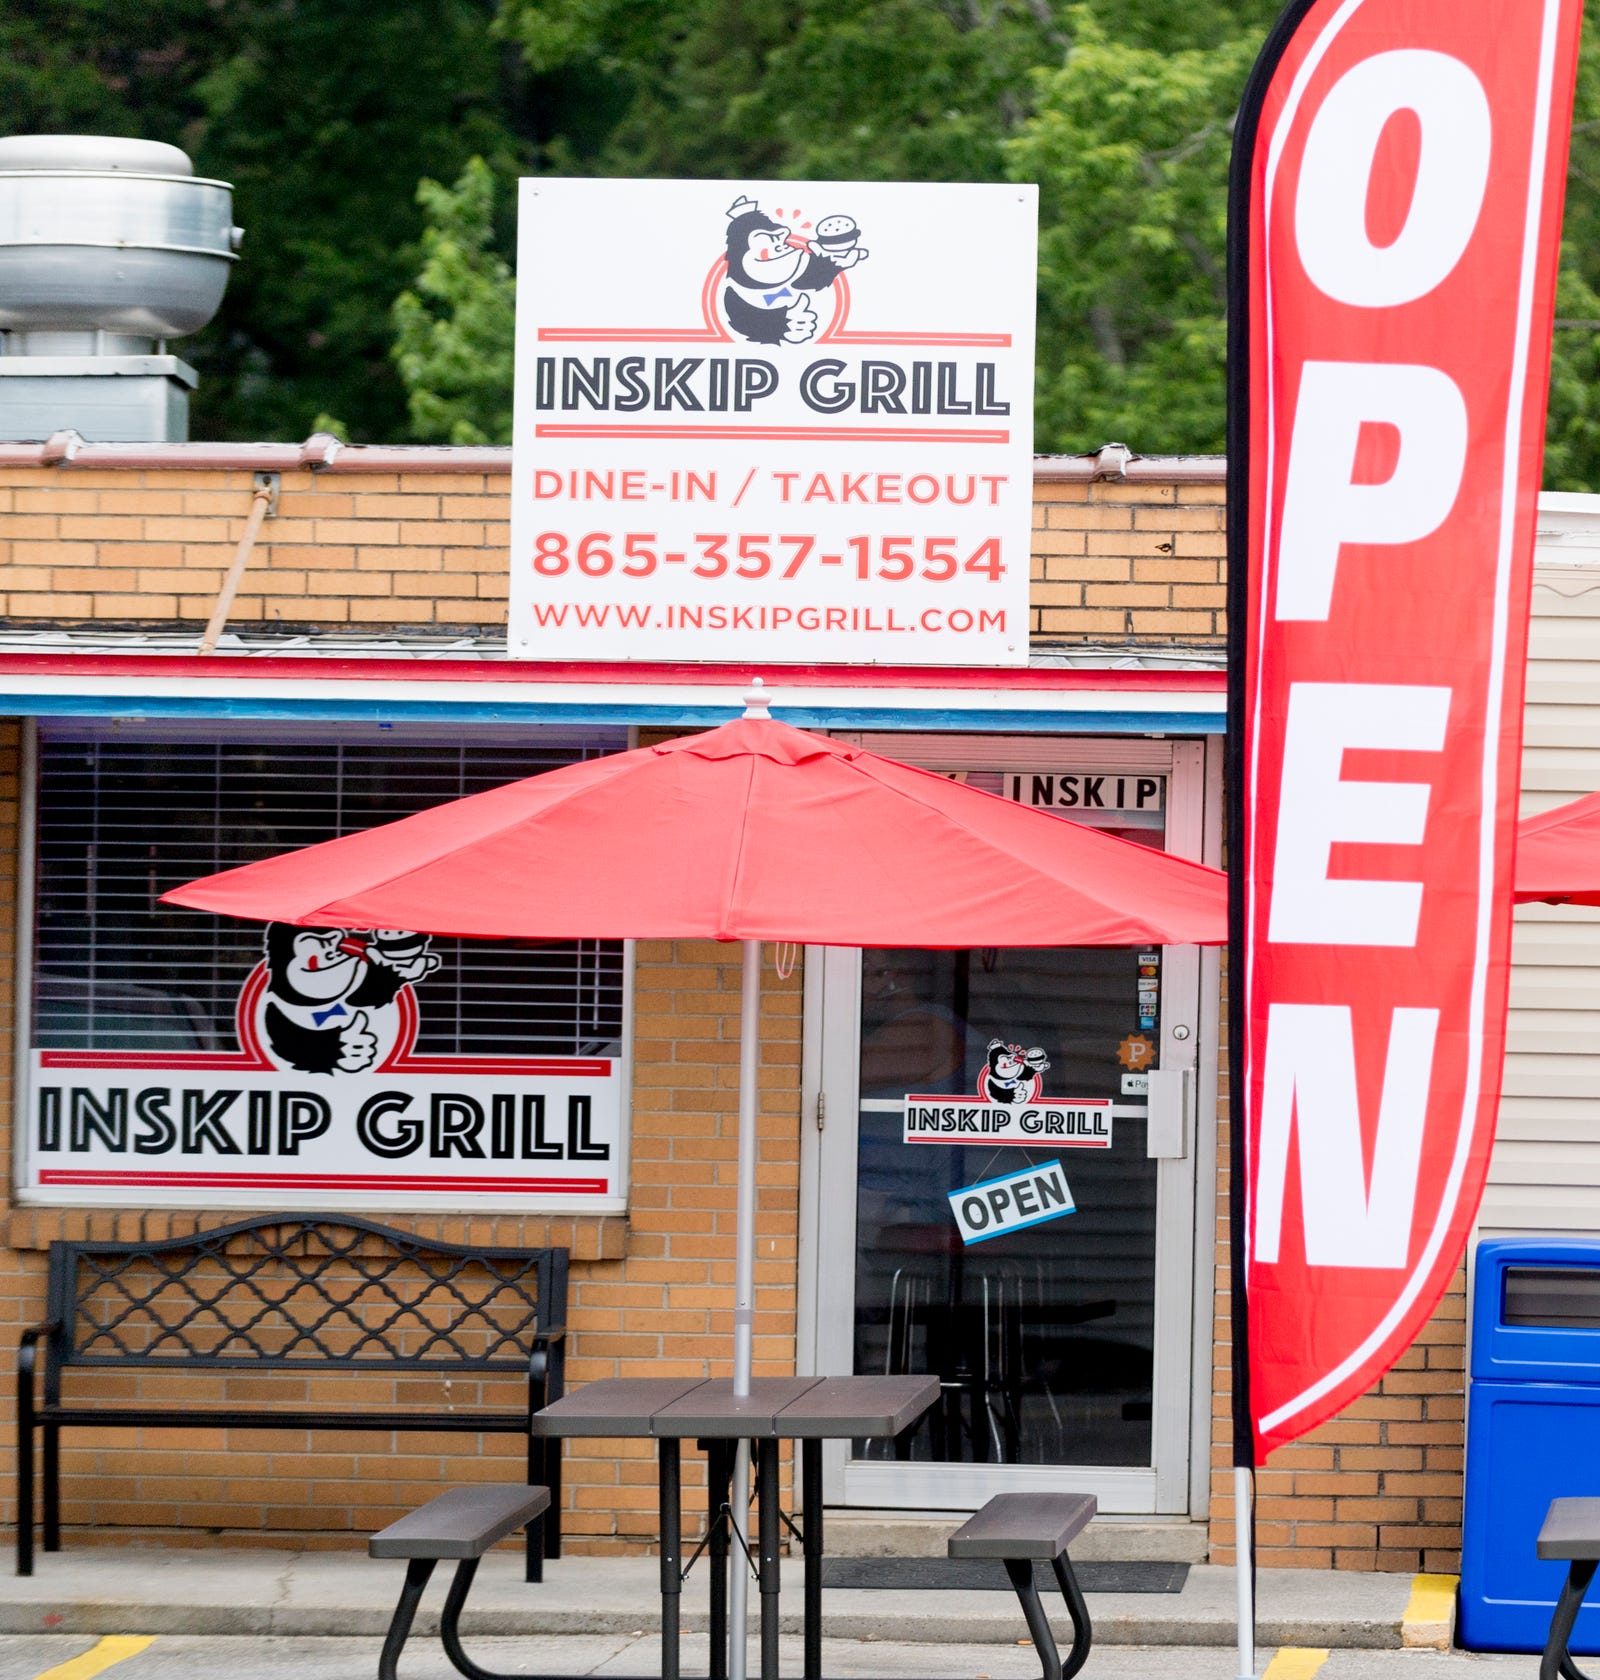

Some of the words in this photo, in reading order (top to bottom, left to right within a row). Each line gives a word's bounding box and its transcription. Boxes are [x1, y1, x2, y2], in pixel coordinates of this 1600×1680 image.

[535, 356, 780, 413] INSKIP
[799, 358, 1011, 417] GRILL
[532, 469, 718, 503] DINE-IN
[730, 467, 758, 509] /
[771, 472, 1010, 507] TAKEOUT
[531, 530, 1009, 583] 865-357-1554
[533, 603, 1008, 634] WWW.INSKIPGRILL.COM
[1255, 48, 1491, 1269] OPEN
[1012, 775, 1158, 809] INSKIP
[1128, 1043, 1146, 1062] P
[38, 1086, 332, 1155] INSKIP
[356, 1090, 610, 1161] GRILL
[908, 1107, 1011, 1133] INSKIP
[1019, 1110, 1109, 1136] GRILL
[961, 1171, 1067, 1231] OPEN
